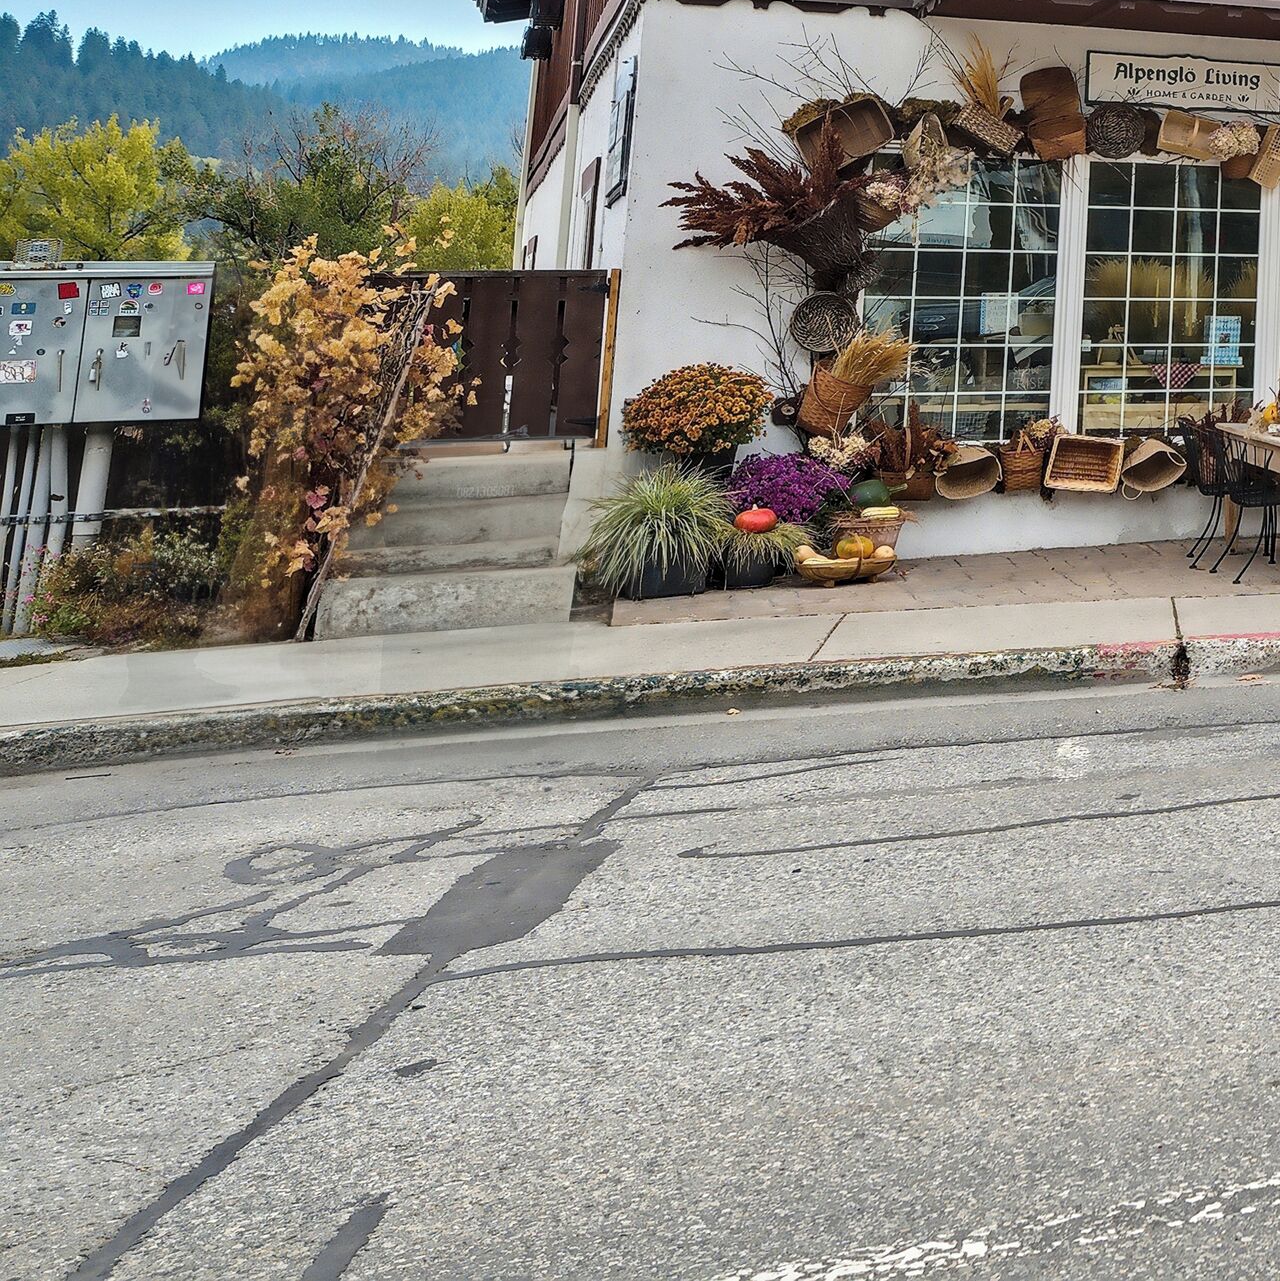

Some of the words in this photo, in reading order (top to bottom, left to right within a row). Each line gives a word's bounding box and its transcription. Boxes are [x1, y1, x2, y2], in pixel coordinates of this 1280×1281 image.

[1113, 62, 1196, 86] Alpenglö
[1204, 68, 1261, 90] Living
[1146, 89, 1178, 99] HOME
[1189, 91, 1233, 102] GARDEN
